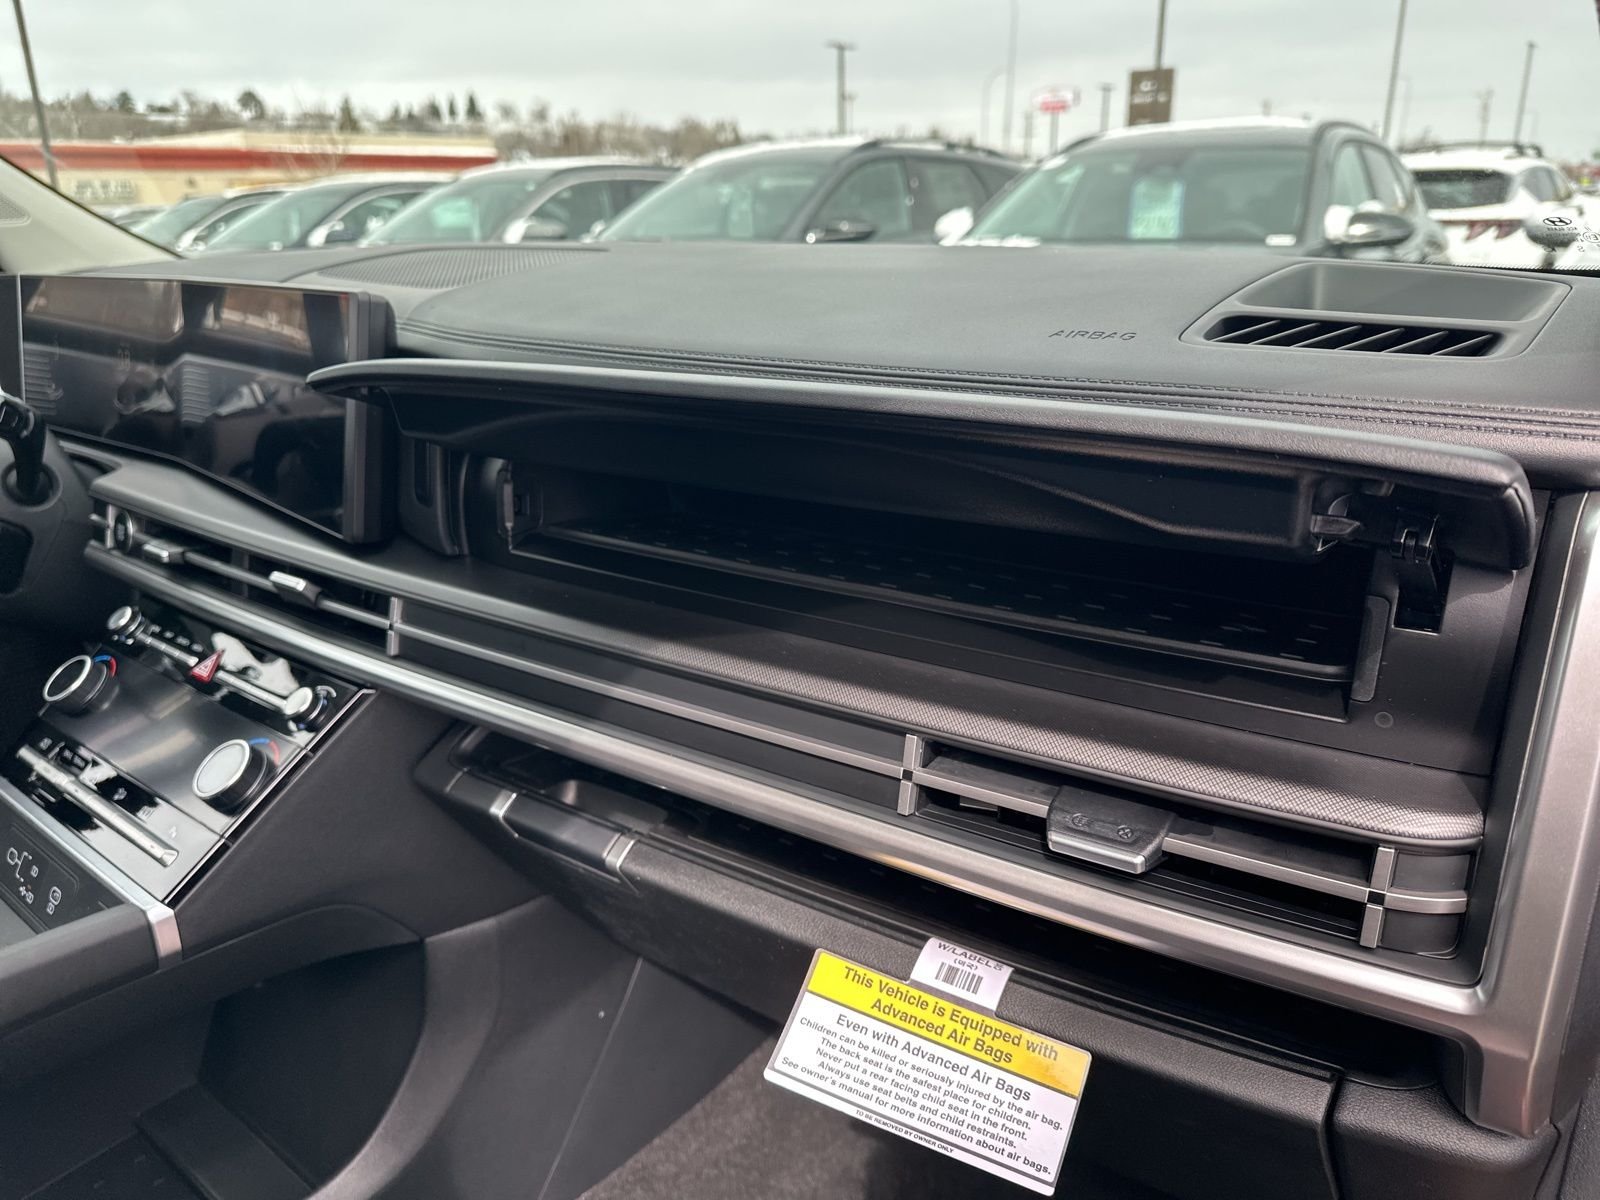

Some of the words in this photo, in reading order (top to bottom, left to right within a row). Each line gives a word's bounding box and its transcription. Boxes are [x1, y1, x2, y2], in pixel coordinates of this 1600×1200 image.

[1048, 330, 1137, 341] AIRBAG
[836, 1013, 869, 1036] Even
[872, 1029, 899, 1049] with
[900, 1041, 970, 1077] Advanced
[970, 1068, 993, 1086] Air
[994, 1077, 1031, 1102] Bags
[844, 965, 874, 989] This
[879, 981, 930, 1011] Vehicle
[931, 1001, 946, 1018] is
[948, 1007, 1023, 1048] Equipped
[1025, 1039, 1059, 1062] with
[870, 997, 946, 1037] Advanced
[946, 1028, 971, 1047] Air
[972, 1037, 1013, 1064] Bags
[781, 1056, 800, 1070] See
[800, 1066, 837, 1086] owner's
[838, 1082, 874, 1102] manual
[874, 1096, 890, 1108] for
[890, 1103, 916, 1119] more
[916, 1113, 974, 1144] information
[975, 1139, 1006, 1156] about
[1006, 1151, 1022, 1162] air
[1022, 1155, 1051, 1175] bags.
[799, 1016, 838, 1039] Children
[838, 1034, 856, 1046] can
[857, 1040, 870, 1052] be
[871, 1046, 898, 1063] killed
[898, 1058, 910, 1068] or
[910, 1063, 955, 1088] seriously
[956, 1080, 992, 1101] injured
[992, 1094, 1006, 1108] by
[1007, 1101, 1024, 1114] the
[1024, 1109, 1040, 1120] air
[1040, 1113, 1063, 1131] bag.
[815, 1047, 843, 1064] Never
[843, 1060, 861, 1072] put
[869, 1071, 889, 1084] rear
[890, 1078, 920, 1099] facing
[921, 1092, 947, 1108] child
[947, 1103, 969, 1117] seat
[970, 1110, 981, 1122] in
[982, 1115, 999, 1129] the
[1000, 1122, 1028, 1141] front.
[817, 1060, 851, 1080] Always
[852, 1076, 871, 1088] use
[871, 1084, 893, 1098] seat
[893, 1091, 918, 1108] belts
[919, 1104, 939, 1117] and
[939, 1112, 966, 1128] child
[966, 1122, 1017, 1149] restraints.
[821, 1036, 838, 1050] The
[838, 1044, 861, 1061] back
[862, 1056, 883, 1070] seat
[884, 1063, 894, 1074] is
[895, 1068, 911, 1081] the
[912, 1076, 942, 1094] safest
[942, 1089, 970, 1105] place
[971, 1099, 987, 1112] for
[987, 1107, 1032, 1131] children.
